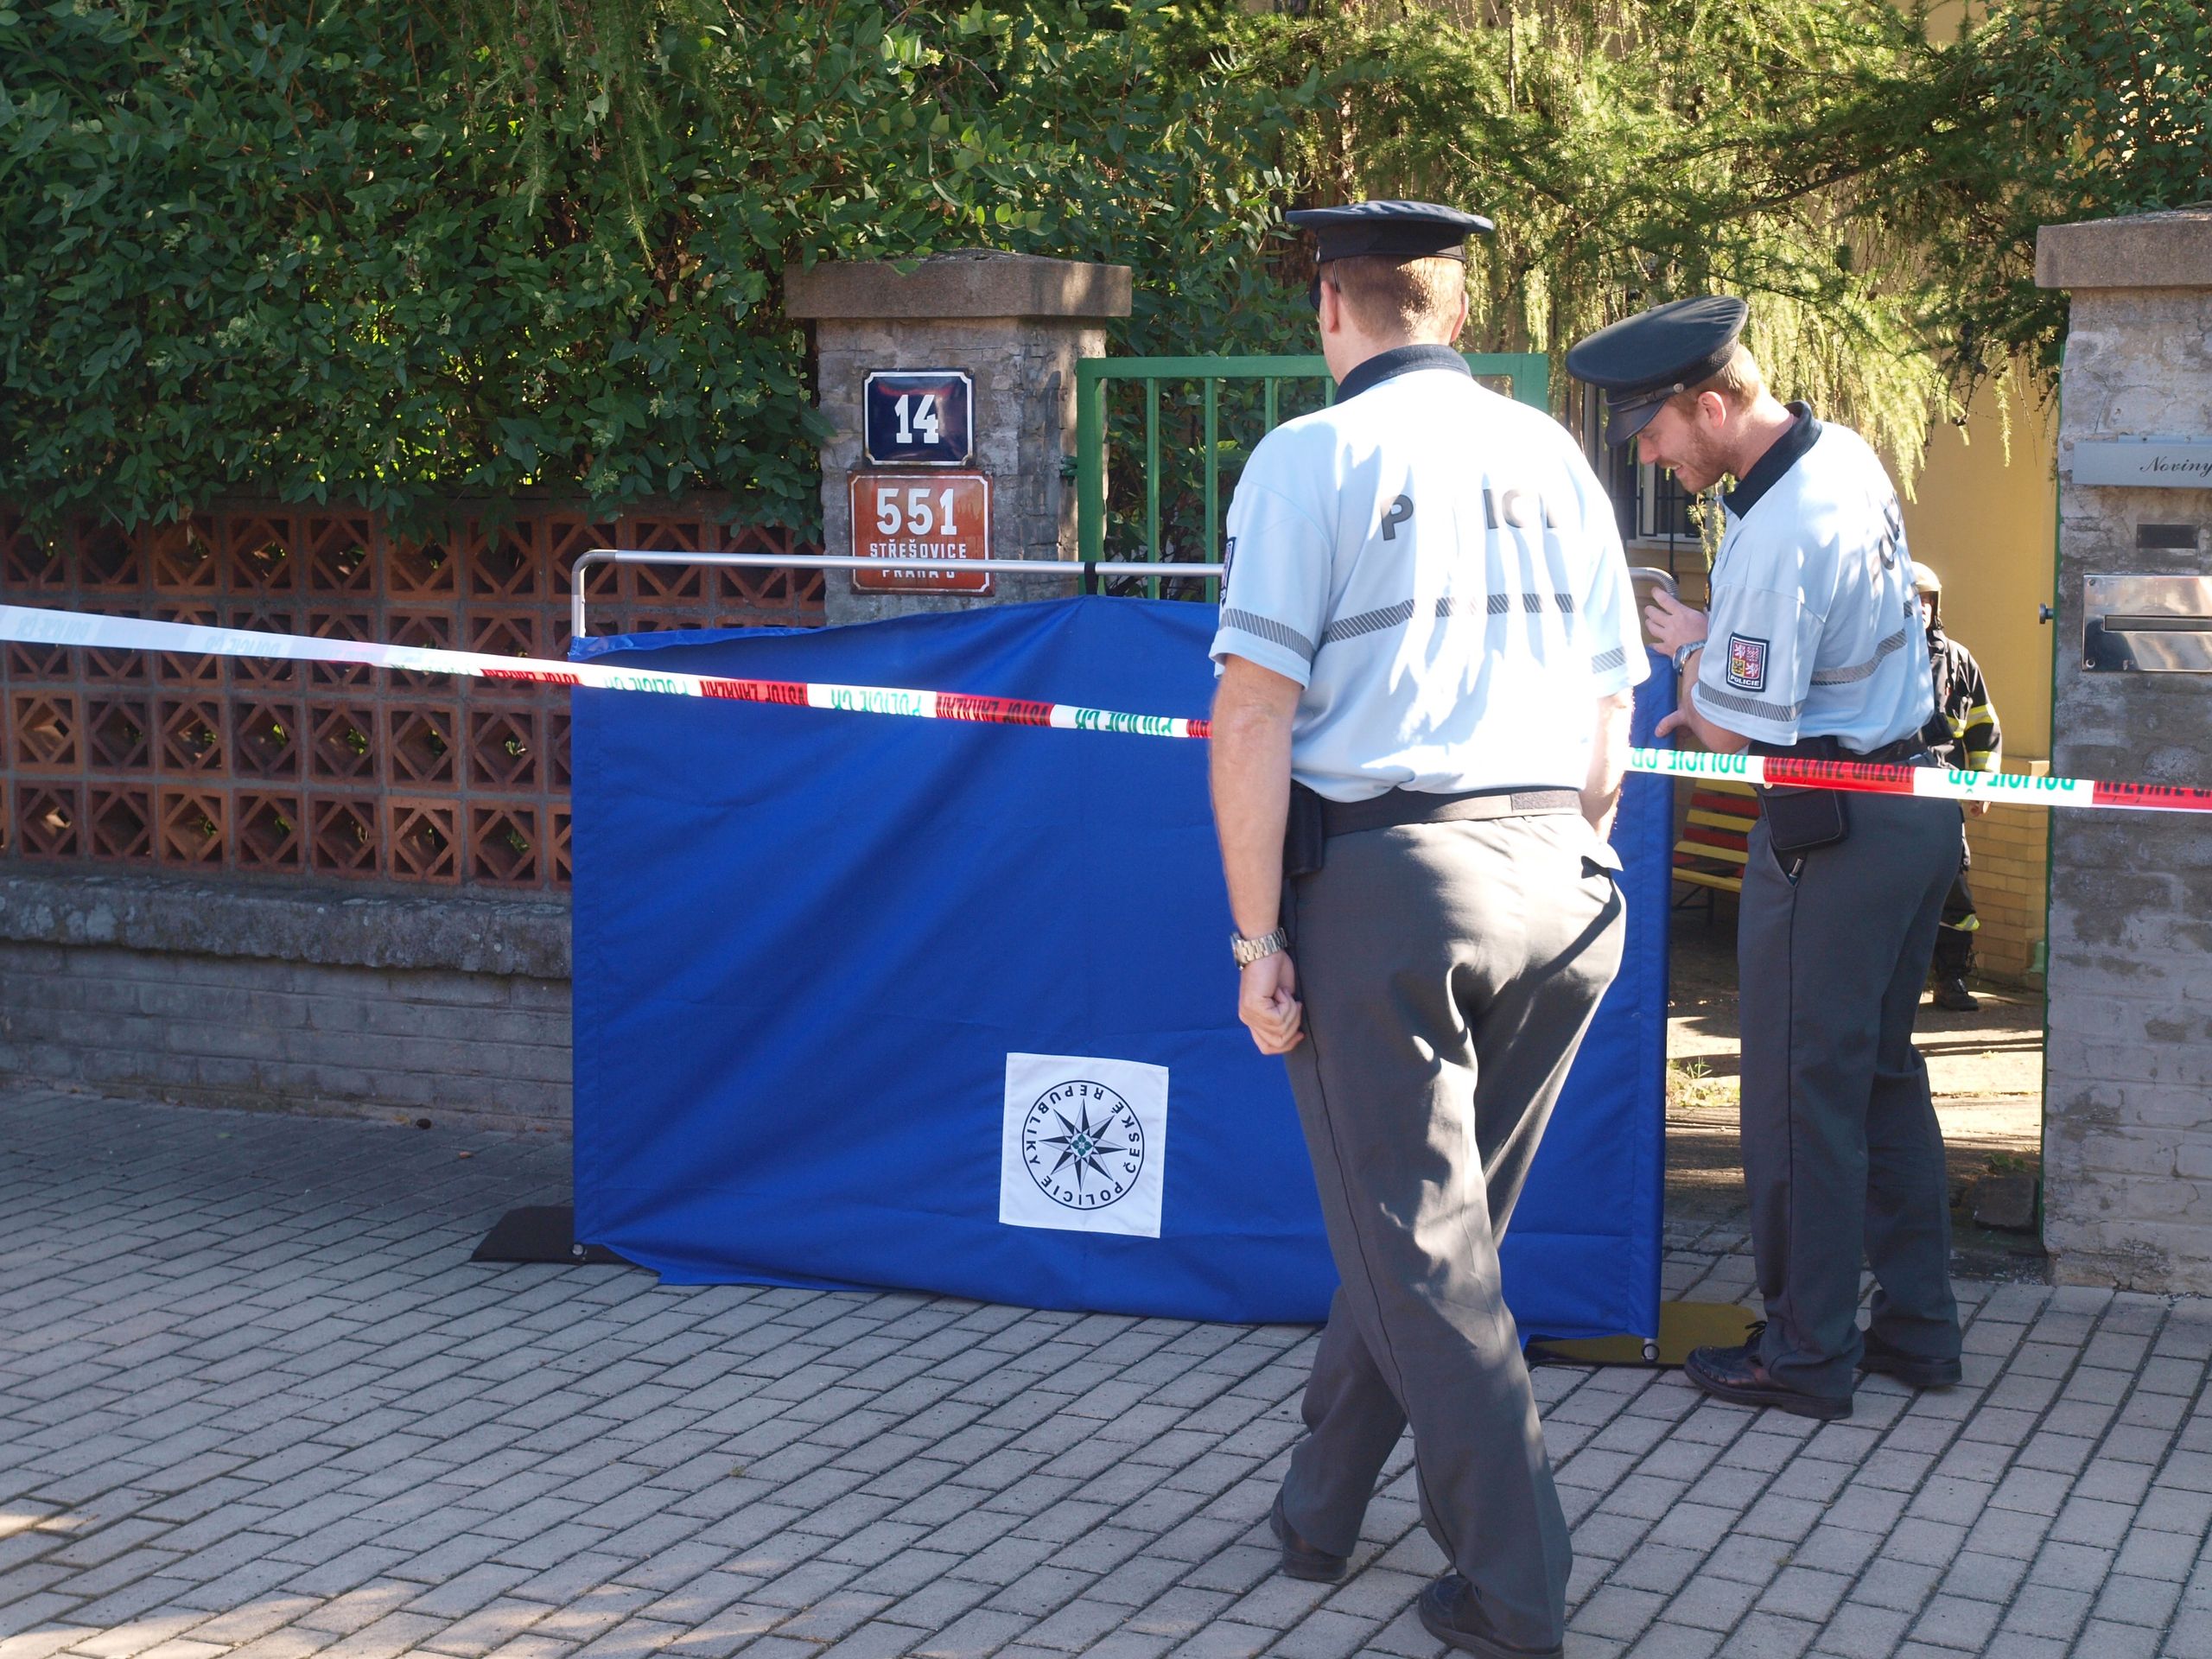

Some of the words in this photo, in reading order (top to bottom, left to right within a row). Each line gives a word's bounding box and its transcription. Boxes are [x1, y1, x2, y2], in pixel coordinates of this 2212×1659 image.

[893, 394, 939, 443] 14
[2139, 455, 2212, 478] Noviny
[876, 487, 957, 536] 551
[869, 538, 967, 558] STŘEŠOVICE
[1730, 674, 1760, 687] POLICIE
[1026, 1084, 1104, 1166] REPUBLIKY
[1110, 1101, 1141, 1174] ČESKÉ
[1040, 1175, 1124, 1205] POLICIE
